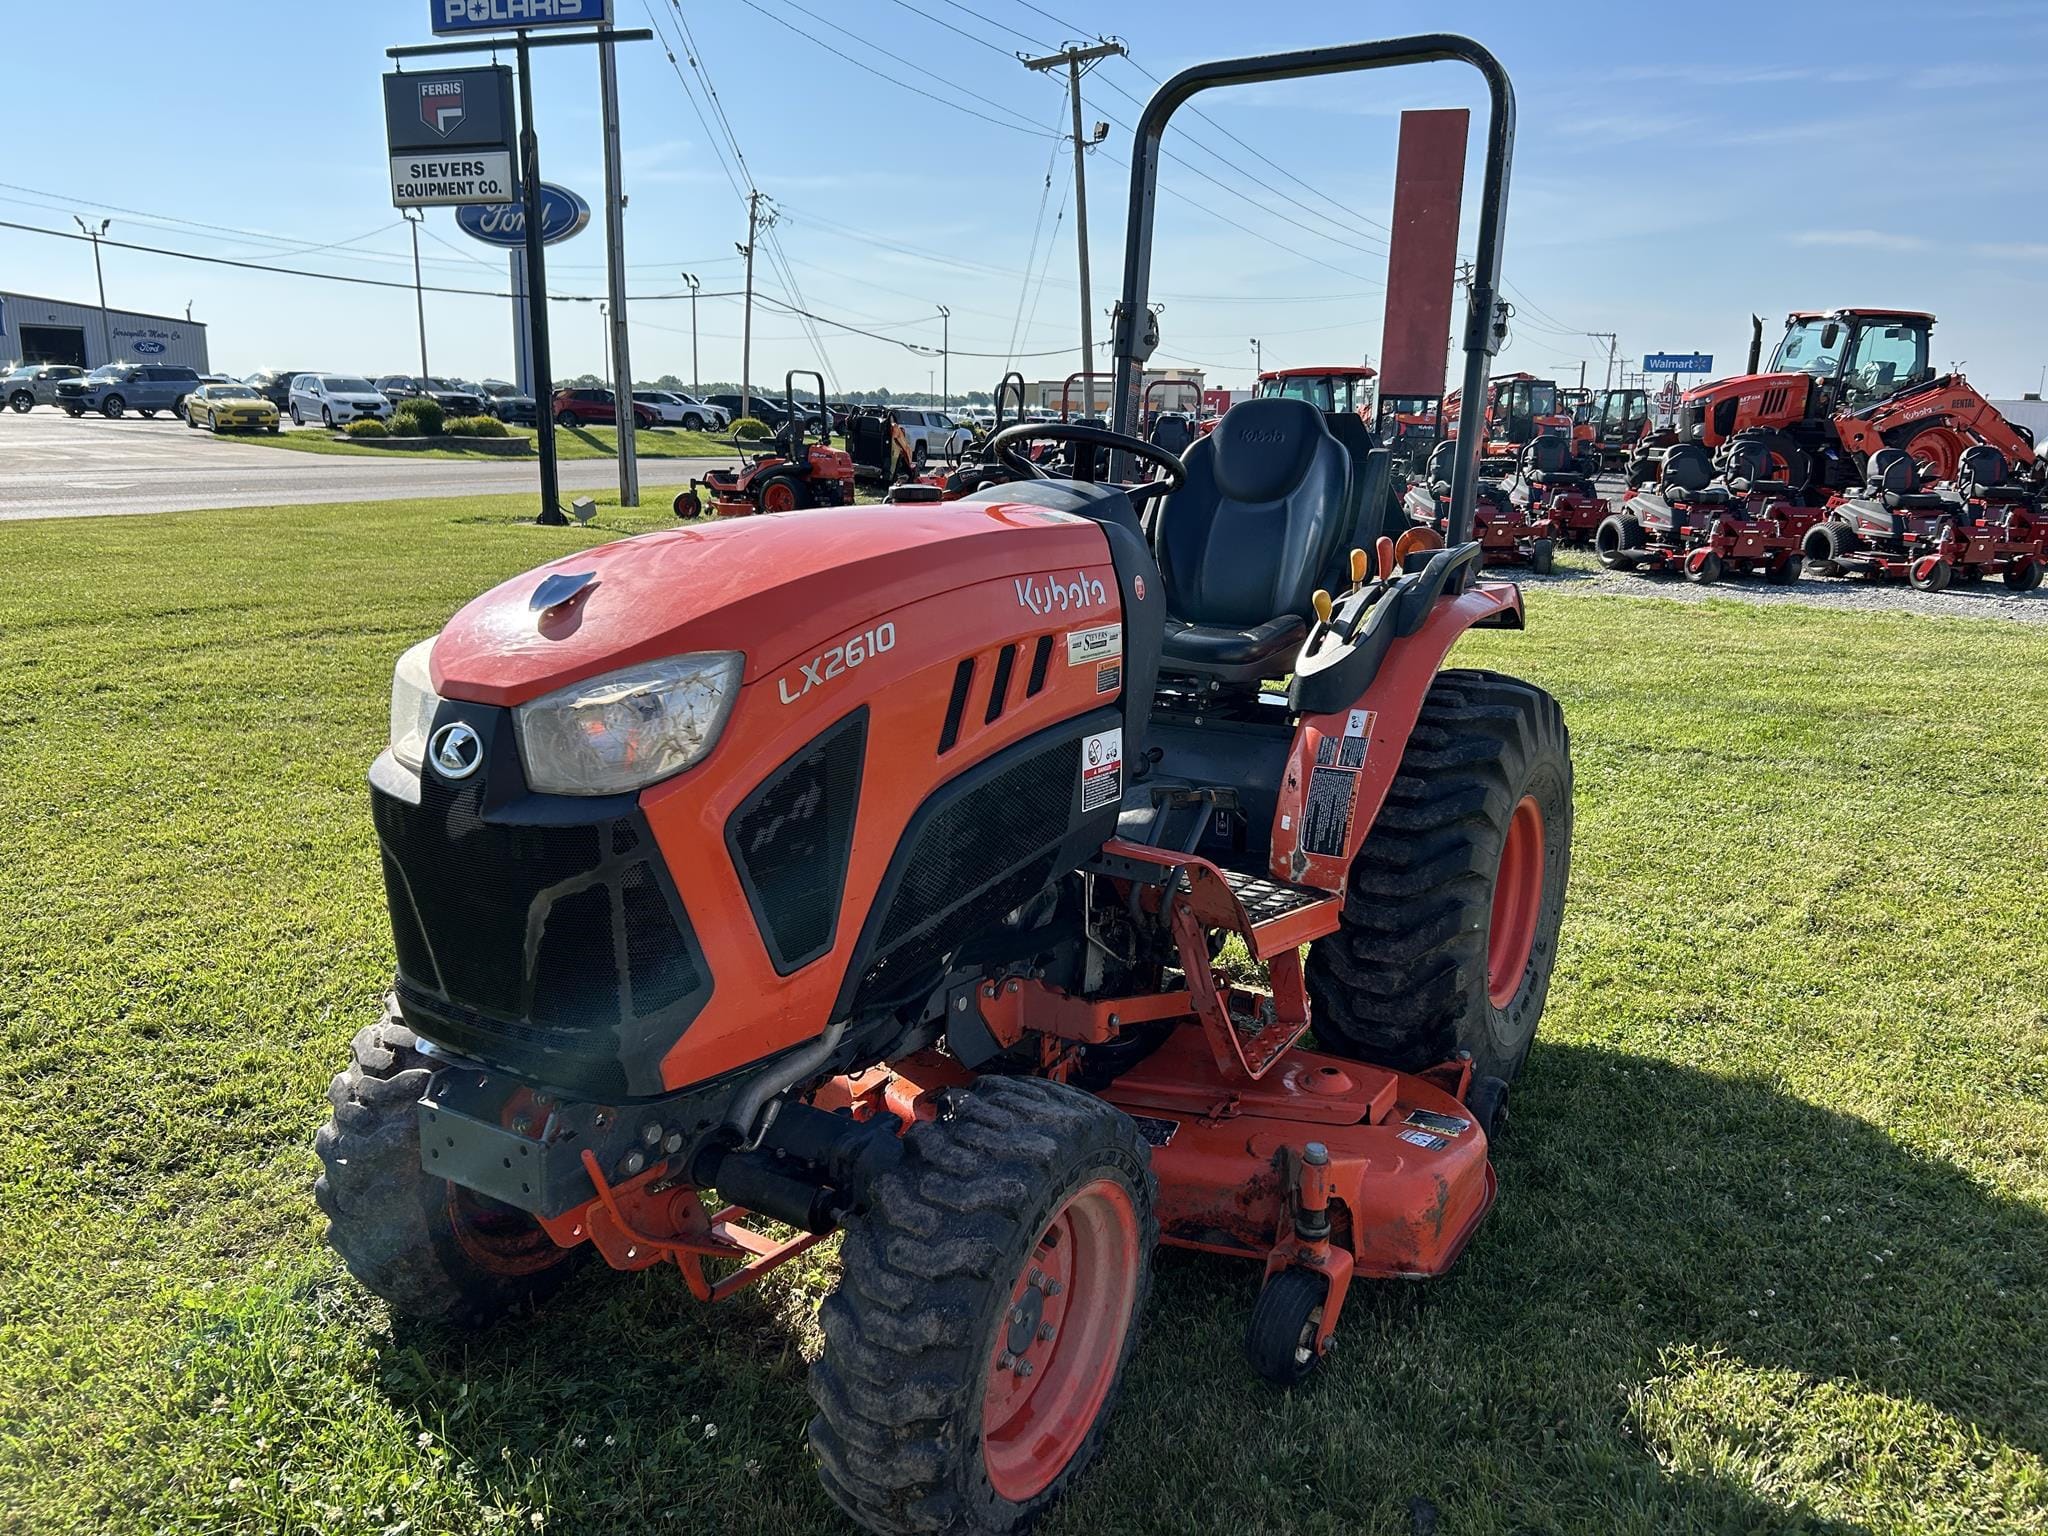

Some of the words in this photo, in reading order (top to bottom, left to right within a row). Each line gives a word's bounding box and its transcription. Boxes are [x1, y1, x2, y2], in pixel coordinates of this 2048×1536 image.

[445, 0, 582, 23] POLARIS
[421, 82, 461, 97] FERRIS
[410, 160, 485, 179] SIEVERS
[396, 181, 474, 198] EQUIPMENT
[478, 180, 502, 195] CO.
[139, 342, 160, 353] Ford
[1649, 359, 1693, 369] Walmart
[1951, 399, 1975, 408] RENTAL
[1903, 407, 1932, 420] Kubota
[1014, 571, 1107, 615] Kubota
[778, 621, 896, 705] LX2610
